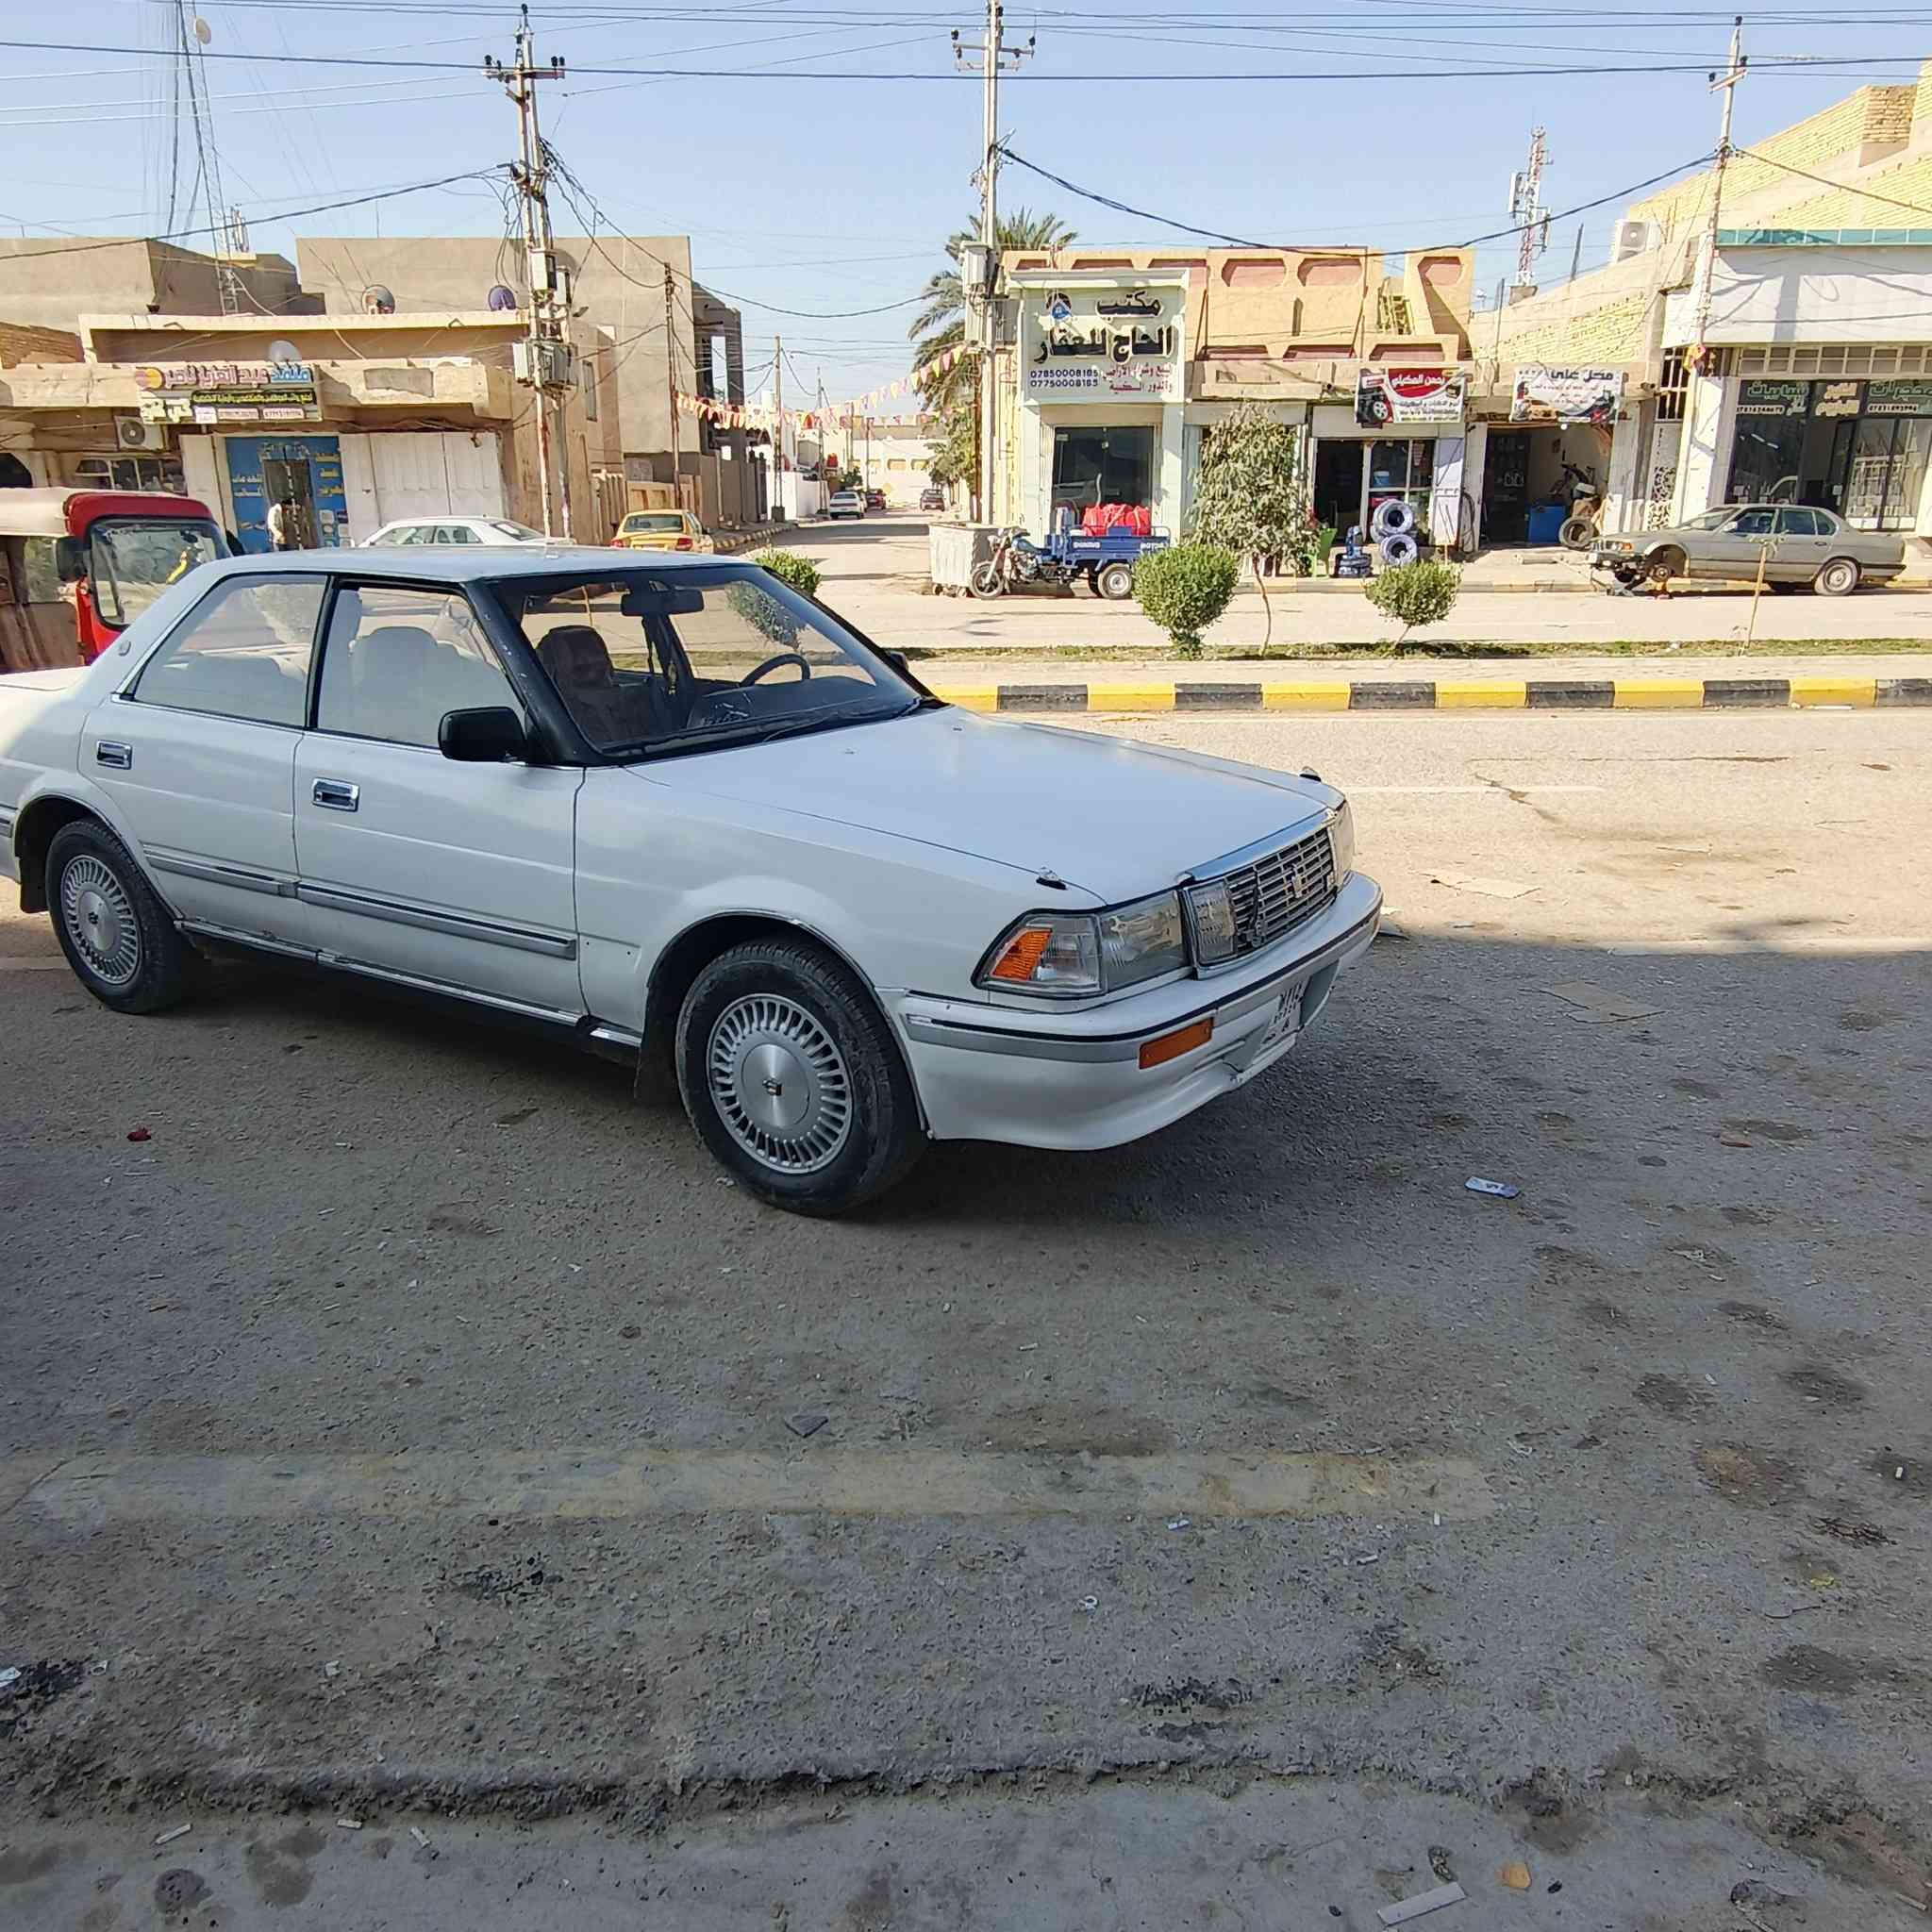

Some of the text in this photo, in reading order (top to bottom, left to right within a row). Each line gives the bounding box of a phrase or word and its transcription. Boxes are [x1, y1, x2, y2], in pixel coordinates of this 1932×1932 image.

[1097, 291, 1163, 322] مكتب
[1034, 325, 1173, 364] الحاج للعقار
[238, 365, 270, 388] عبد
